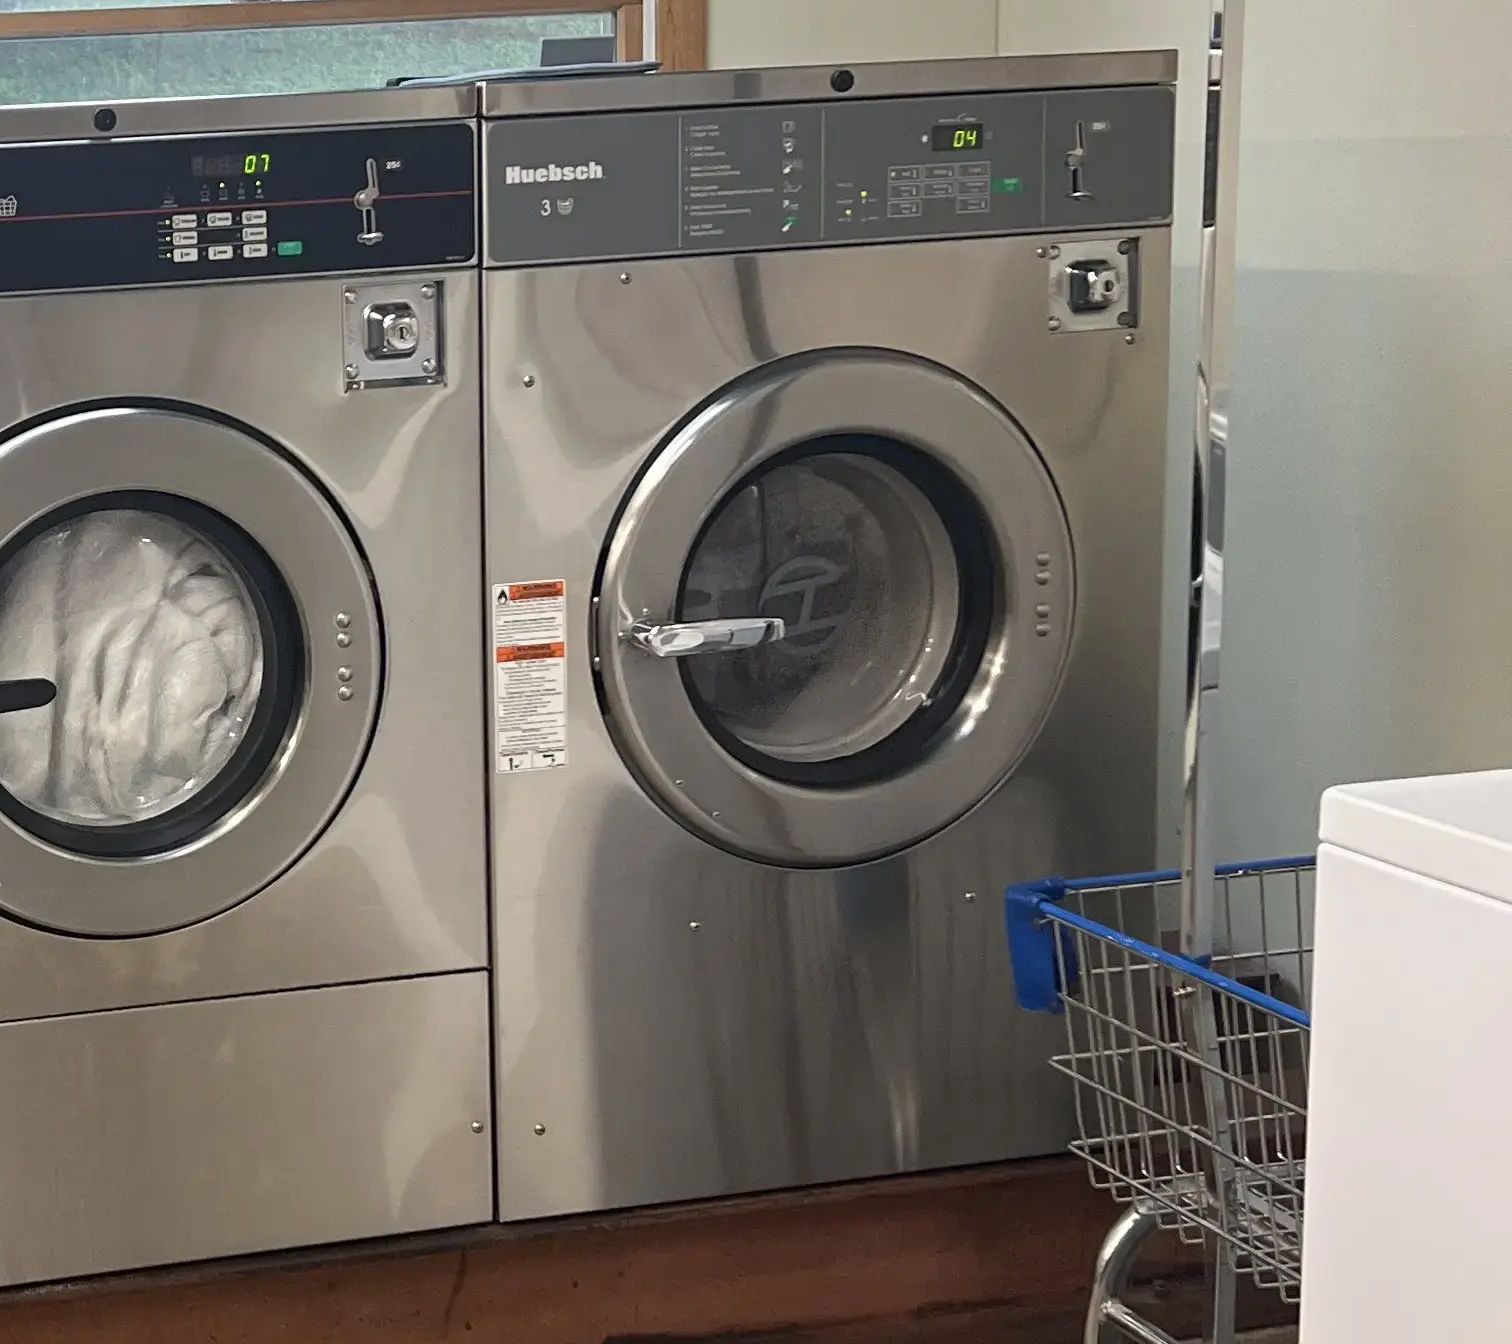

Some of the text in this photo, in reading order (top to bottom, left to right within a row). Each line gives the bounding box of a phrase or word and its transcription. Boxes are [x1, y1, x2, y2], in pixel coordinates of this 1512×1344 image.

[952, 129, 977, 148] 04
[244, 153, 270, 174] 07
[504, 161, 604, 185] Huebsch
[540, 199, 552, 217] 3
